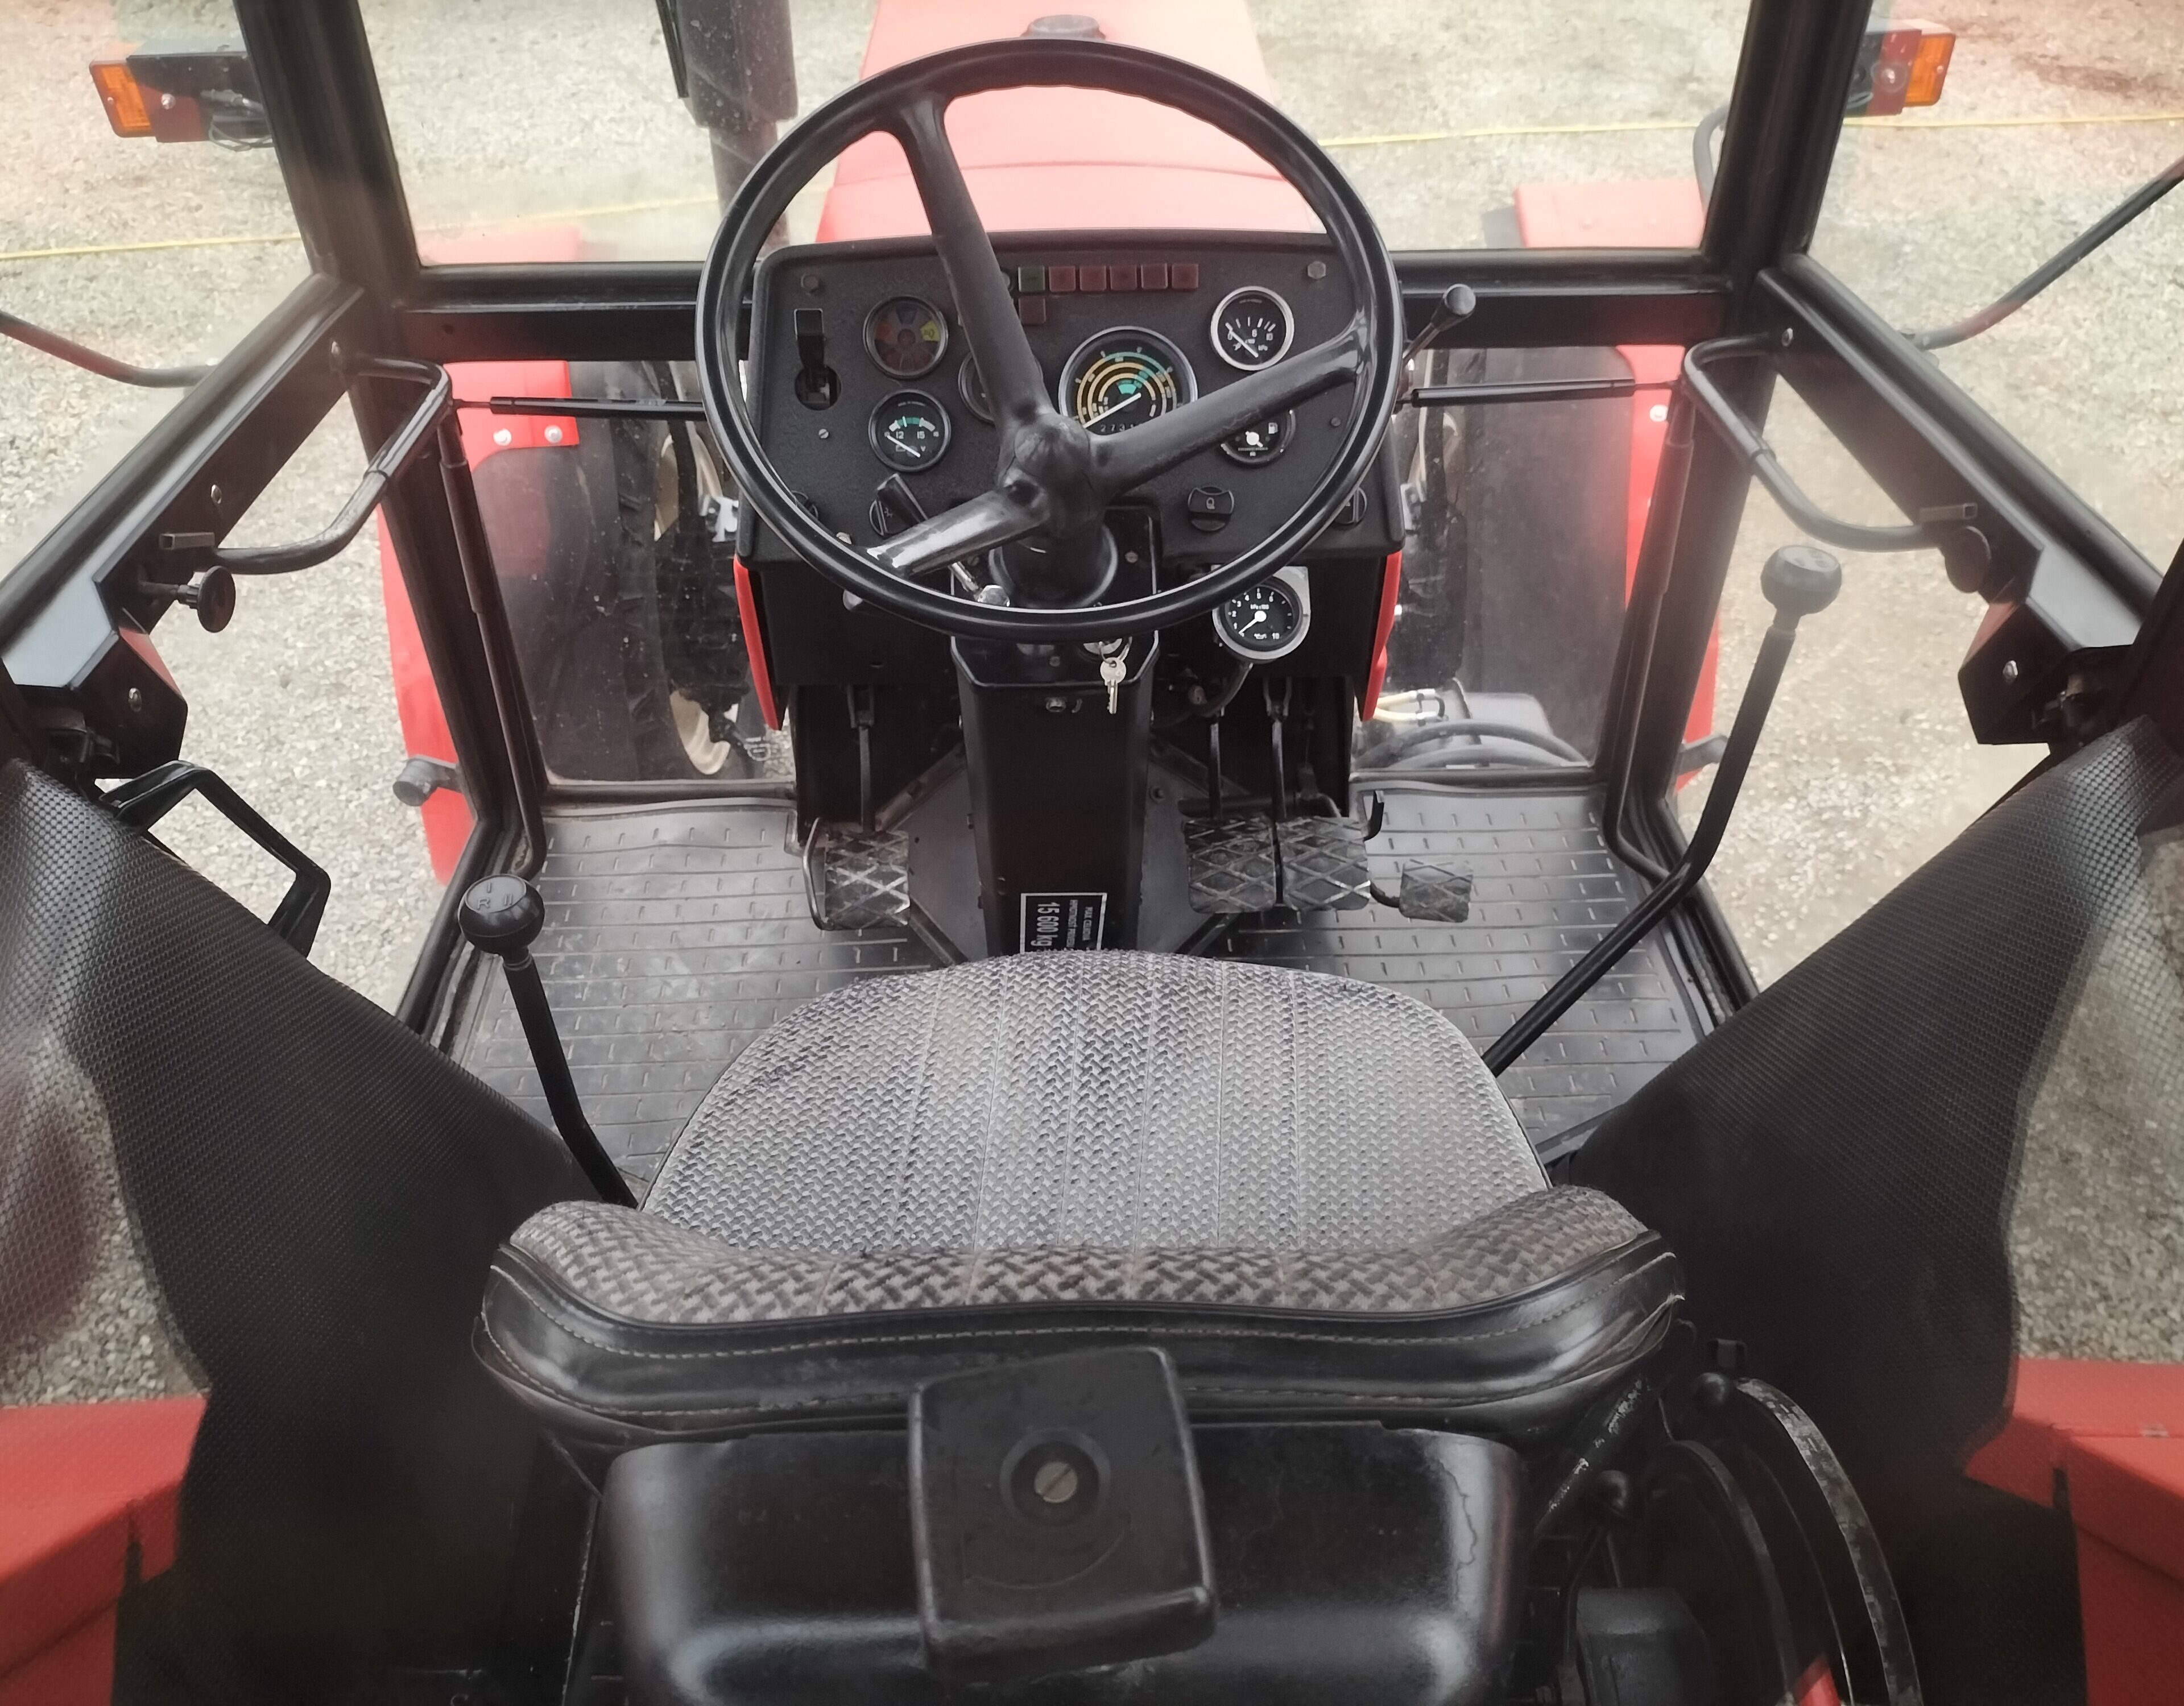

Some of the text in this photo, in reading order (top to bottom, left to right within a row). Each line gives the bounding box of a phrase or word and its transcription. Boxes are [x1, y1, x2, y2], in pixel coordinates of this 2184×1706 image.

[917, 430, 925, 439] 15
[477, 898, 491, 910] R
[1031, 902, 1060, 946] 15 600 kg
